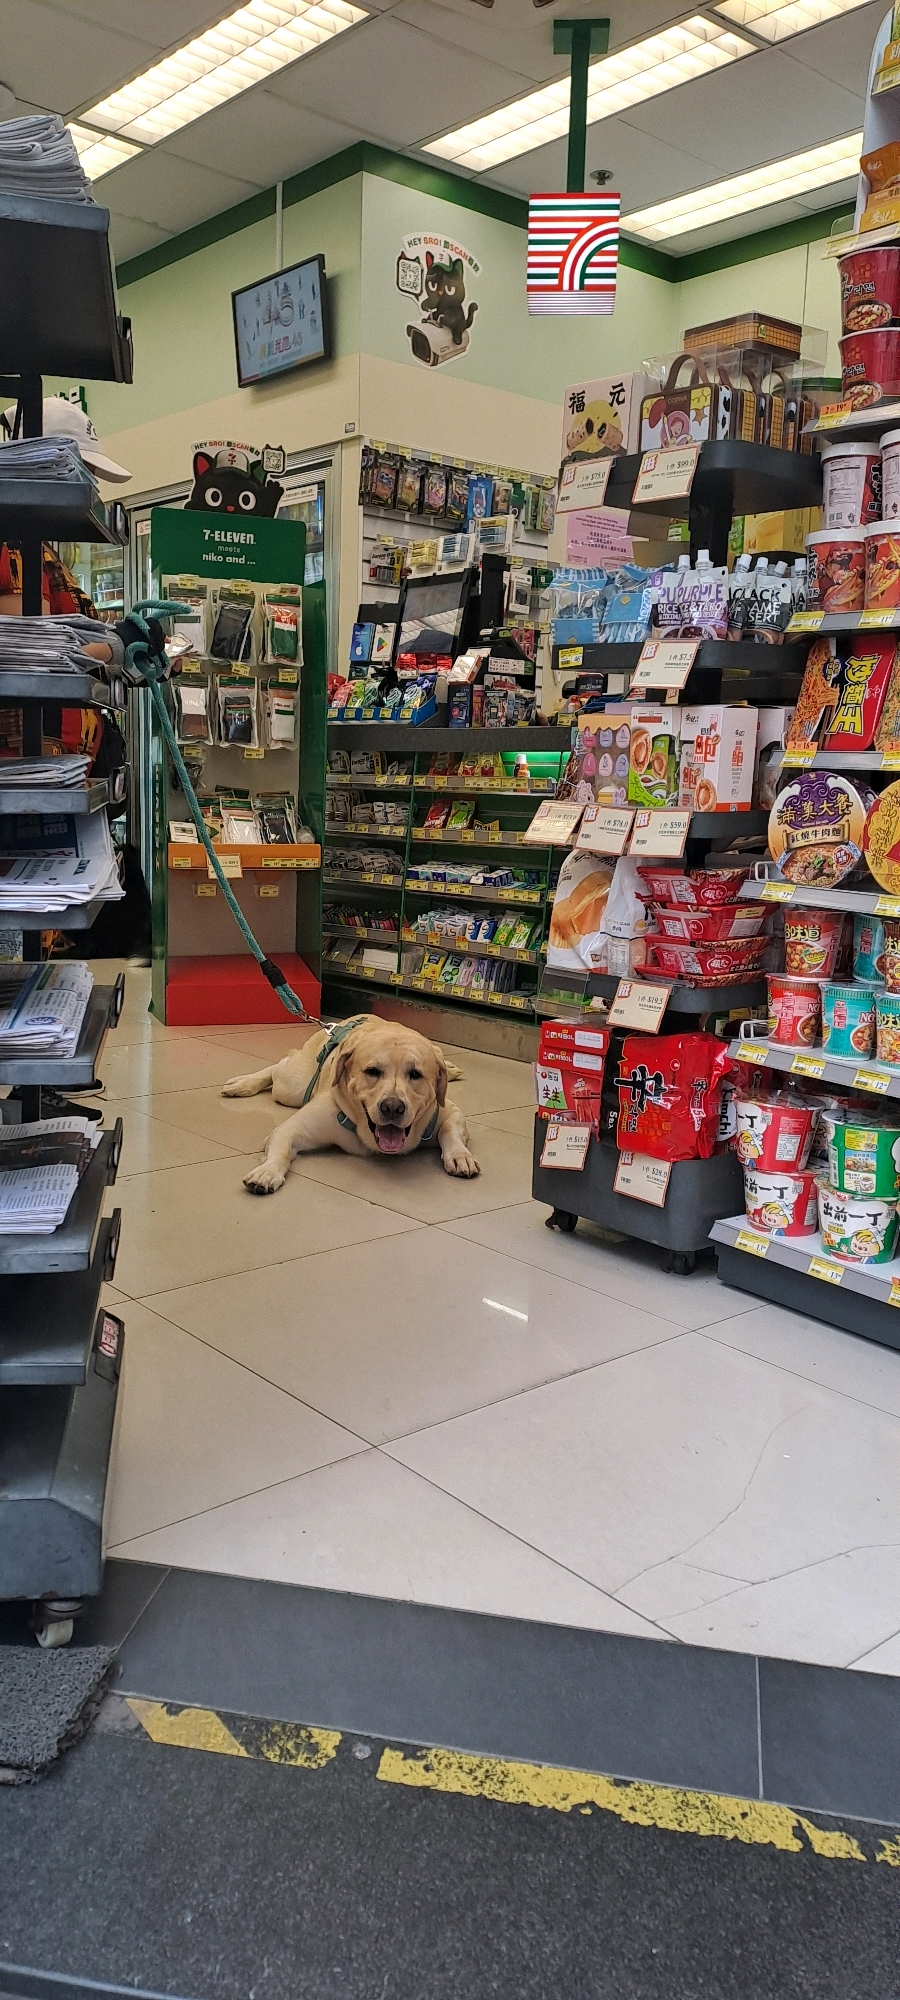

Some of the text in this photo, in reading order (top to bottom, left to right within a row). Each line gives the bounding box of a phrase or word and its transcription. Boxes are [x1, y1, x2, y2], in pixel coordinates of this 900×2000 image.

[407, 237, 422, 248] HEY
[423, 236, 442, 247] BRO!
[568, 382, 626, 415] 福 元
[194, 442, 207, 450] HEY
[217, 545, 241, 553] meets
[202, 553, 223, 563] niko
[226, 555, 245, 565] and
[777, 793, 853, 825] 滿漢大餐
[614, 1064, 668, 1114] 辛
[823, 1202, 883, 1226] 出前一丁
